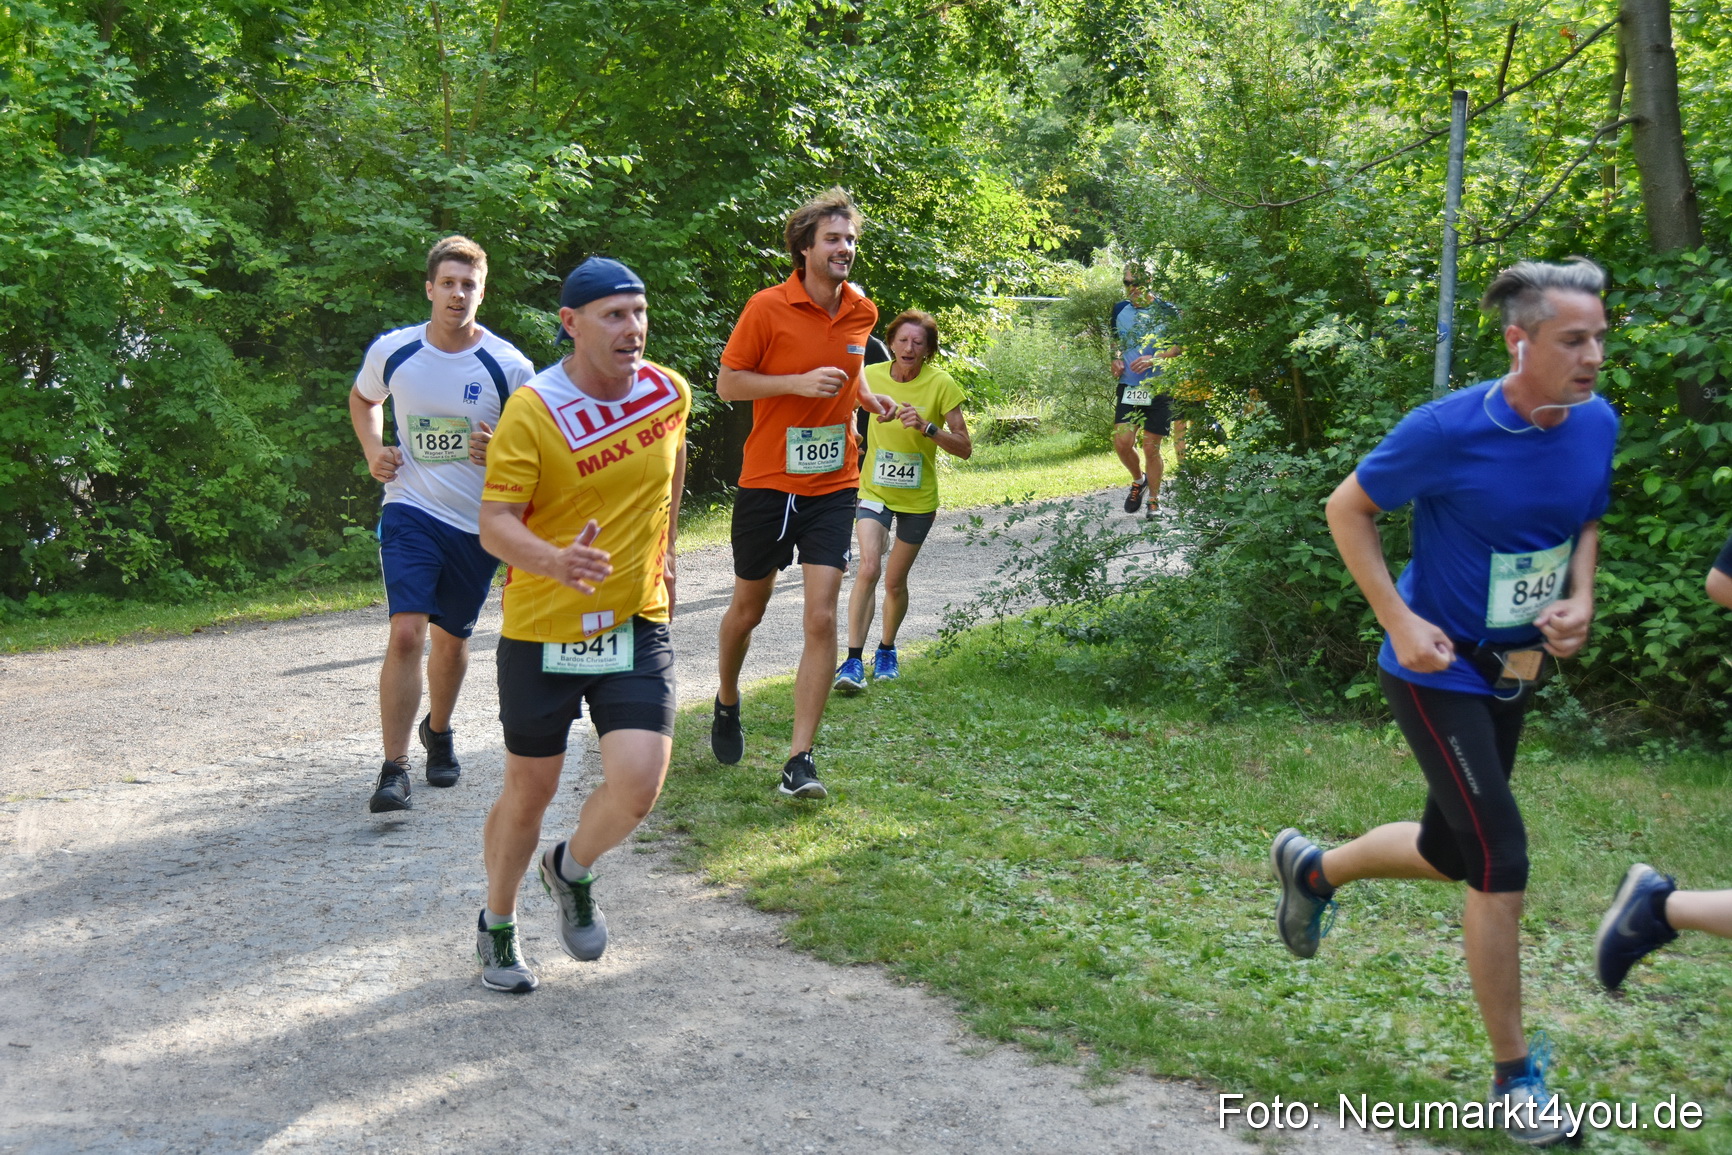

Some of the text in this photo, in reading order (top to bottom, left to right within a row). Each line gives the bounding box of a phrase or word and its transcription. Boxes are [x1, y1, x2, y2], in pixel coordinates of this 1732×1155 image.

[1127, 390, 1148, 399] 2120
[416, 433, 463, 450] 1882
[576, 439, 634, 477] MAX
[796, 442, 838, 461] 1805
[880, 463, 915, 478] 1244
[1512, 572, 1556, 605] 849
[1447, 735, 1480, 794] SALOMON
